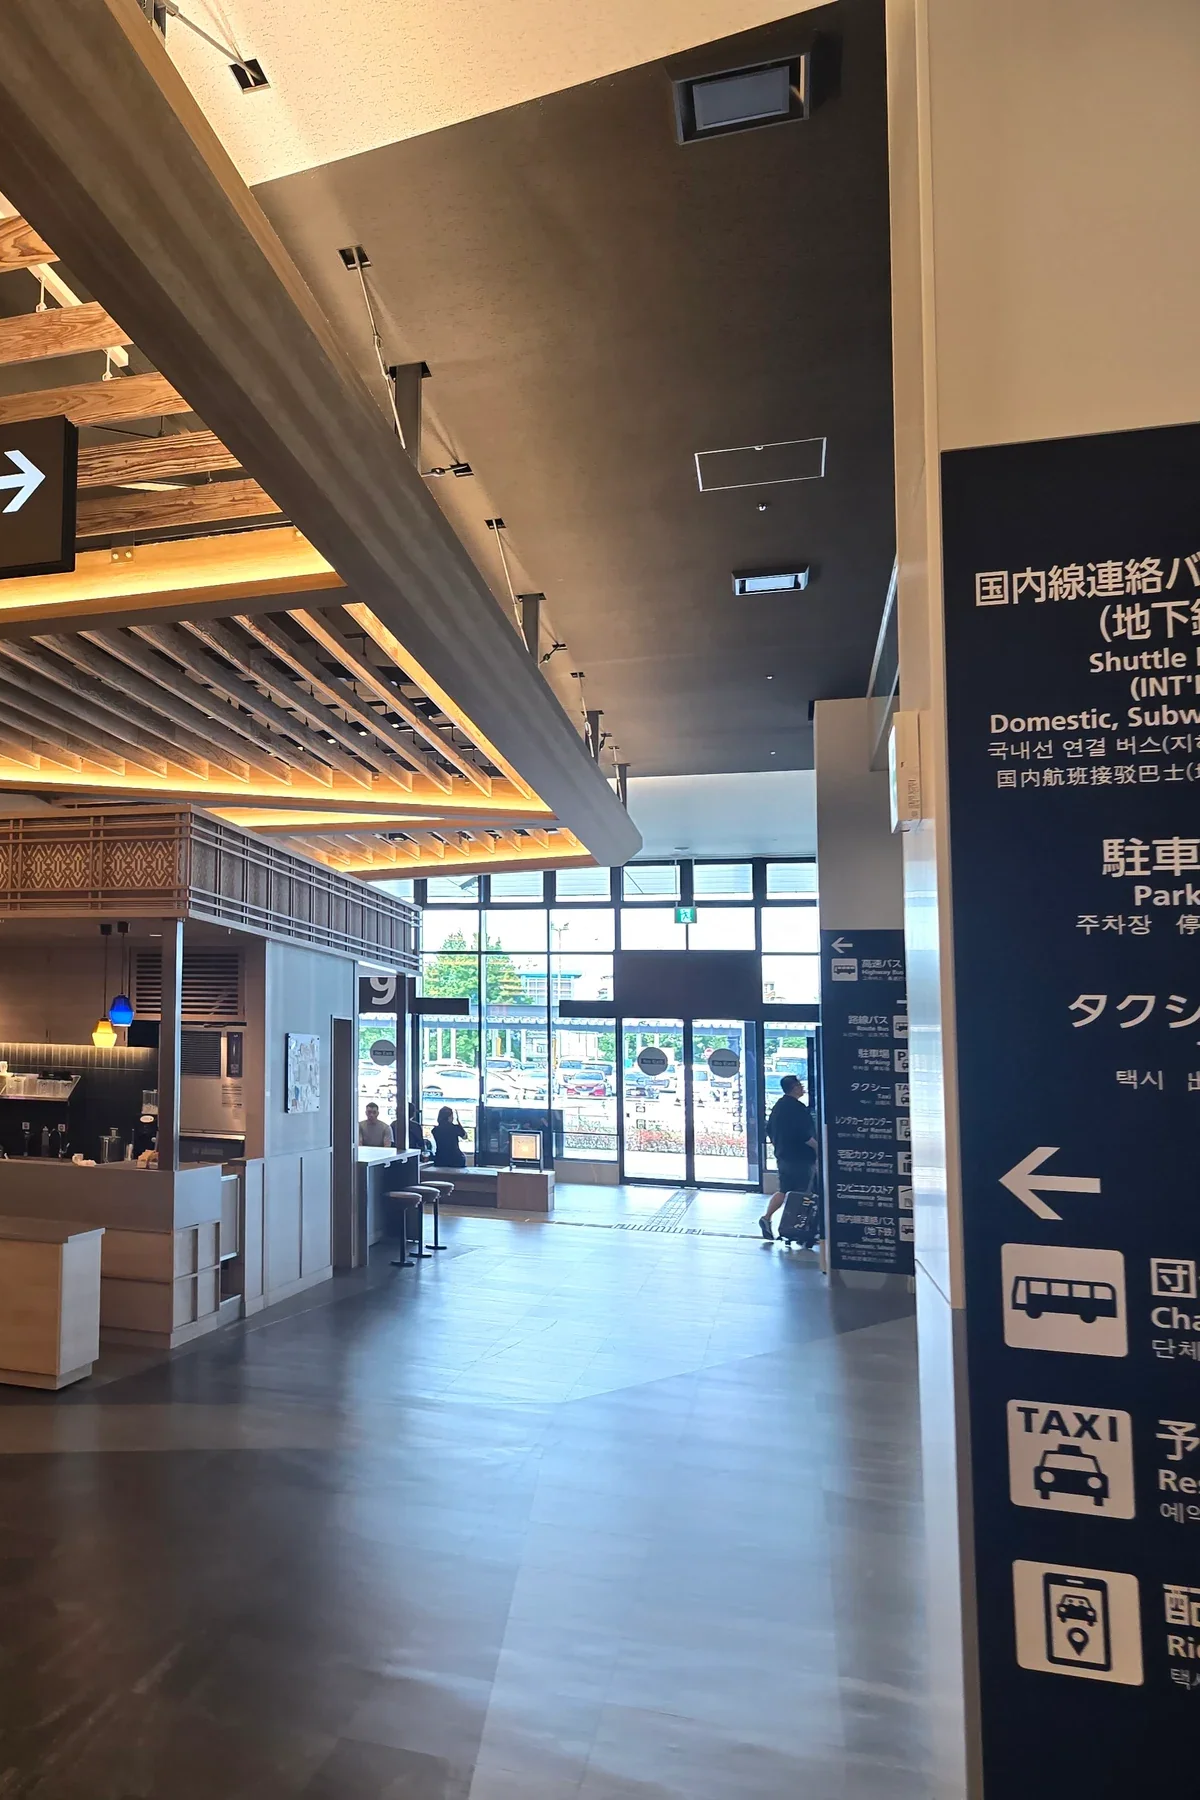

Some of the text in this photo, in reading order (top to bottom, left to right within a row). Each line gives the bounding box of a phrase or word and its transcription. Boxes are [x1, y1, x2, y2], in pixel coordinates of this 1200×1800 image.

[975, 551, 1200, 607] 国内線連絡バ
[1089, 647, 1187, 674] Shuttle
[990, 708, 1119, 734] Domestic,
[987, 739, 1054, 761] 국내선
[1063, 737, 1106, 759] 연결
[997, 762, 1200, 788] 国内航班接驳巴士(
[1102, 836, 1200, 878] 駐車
[1134, 883, 1200, 906] Park
[1075, 913, 1152, 936] 주차장
[369, 977, 396, 1005] 9
[1068, 994, 1200, 1029] タクシ
[897, 1051, 906, 1061] P
[851, 1082, 891, 1092] タクシー
[1115, 1069, 1164, 1091] 택시
[1150, 1257, 1197, 1299] 団
[1016, 1406, 1118, 1443] TAXI
[1155, 1419, 1200, 1461] 予
[1158, 1468, 1200, 1494] Re
[1167, 1634, 1200, 1658] Ri
